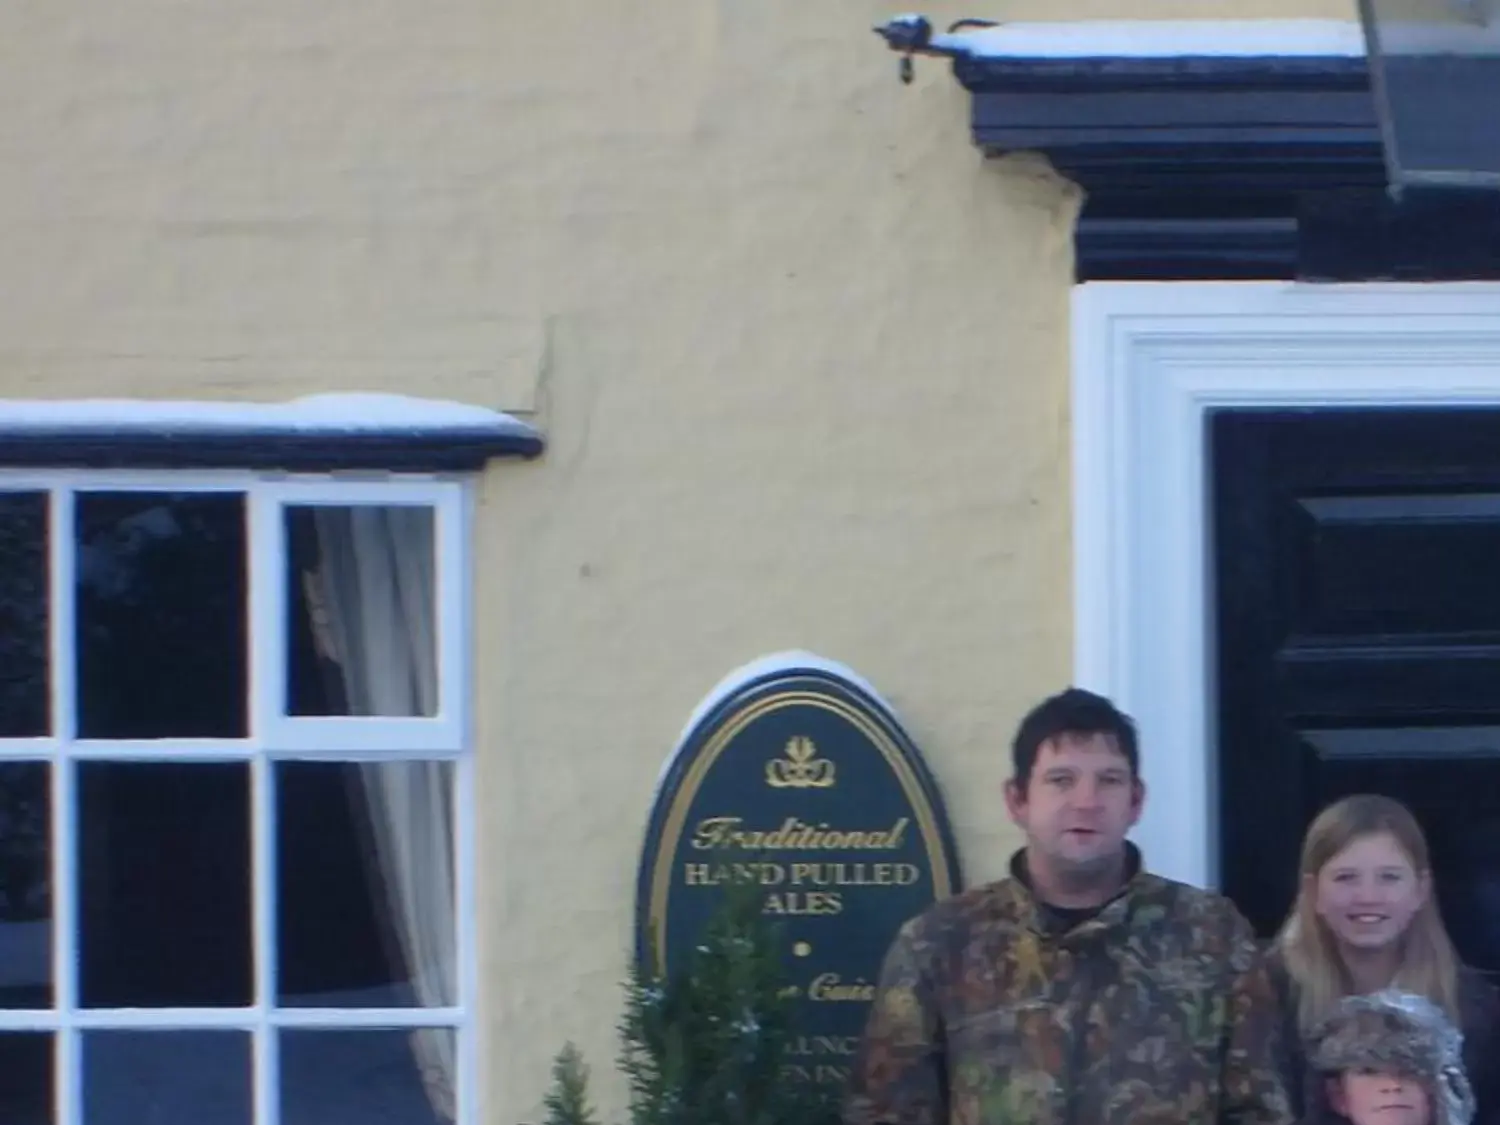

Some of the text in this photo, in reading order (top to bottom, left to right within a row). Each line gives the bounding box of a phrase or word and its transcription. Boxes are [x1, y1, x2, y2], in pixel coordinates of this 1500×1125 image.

[692, 816, 910, 850] Traditional
[685, 863, 920, 885] HAND PULLED
[761, 891, 845, 915] ALES
